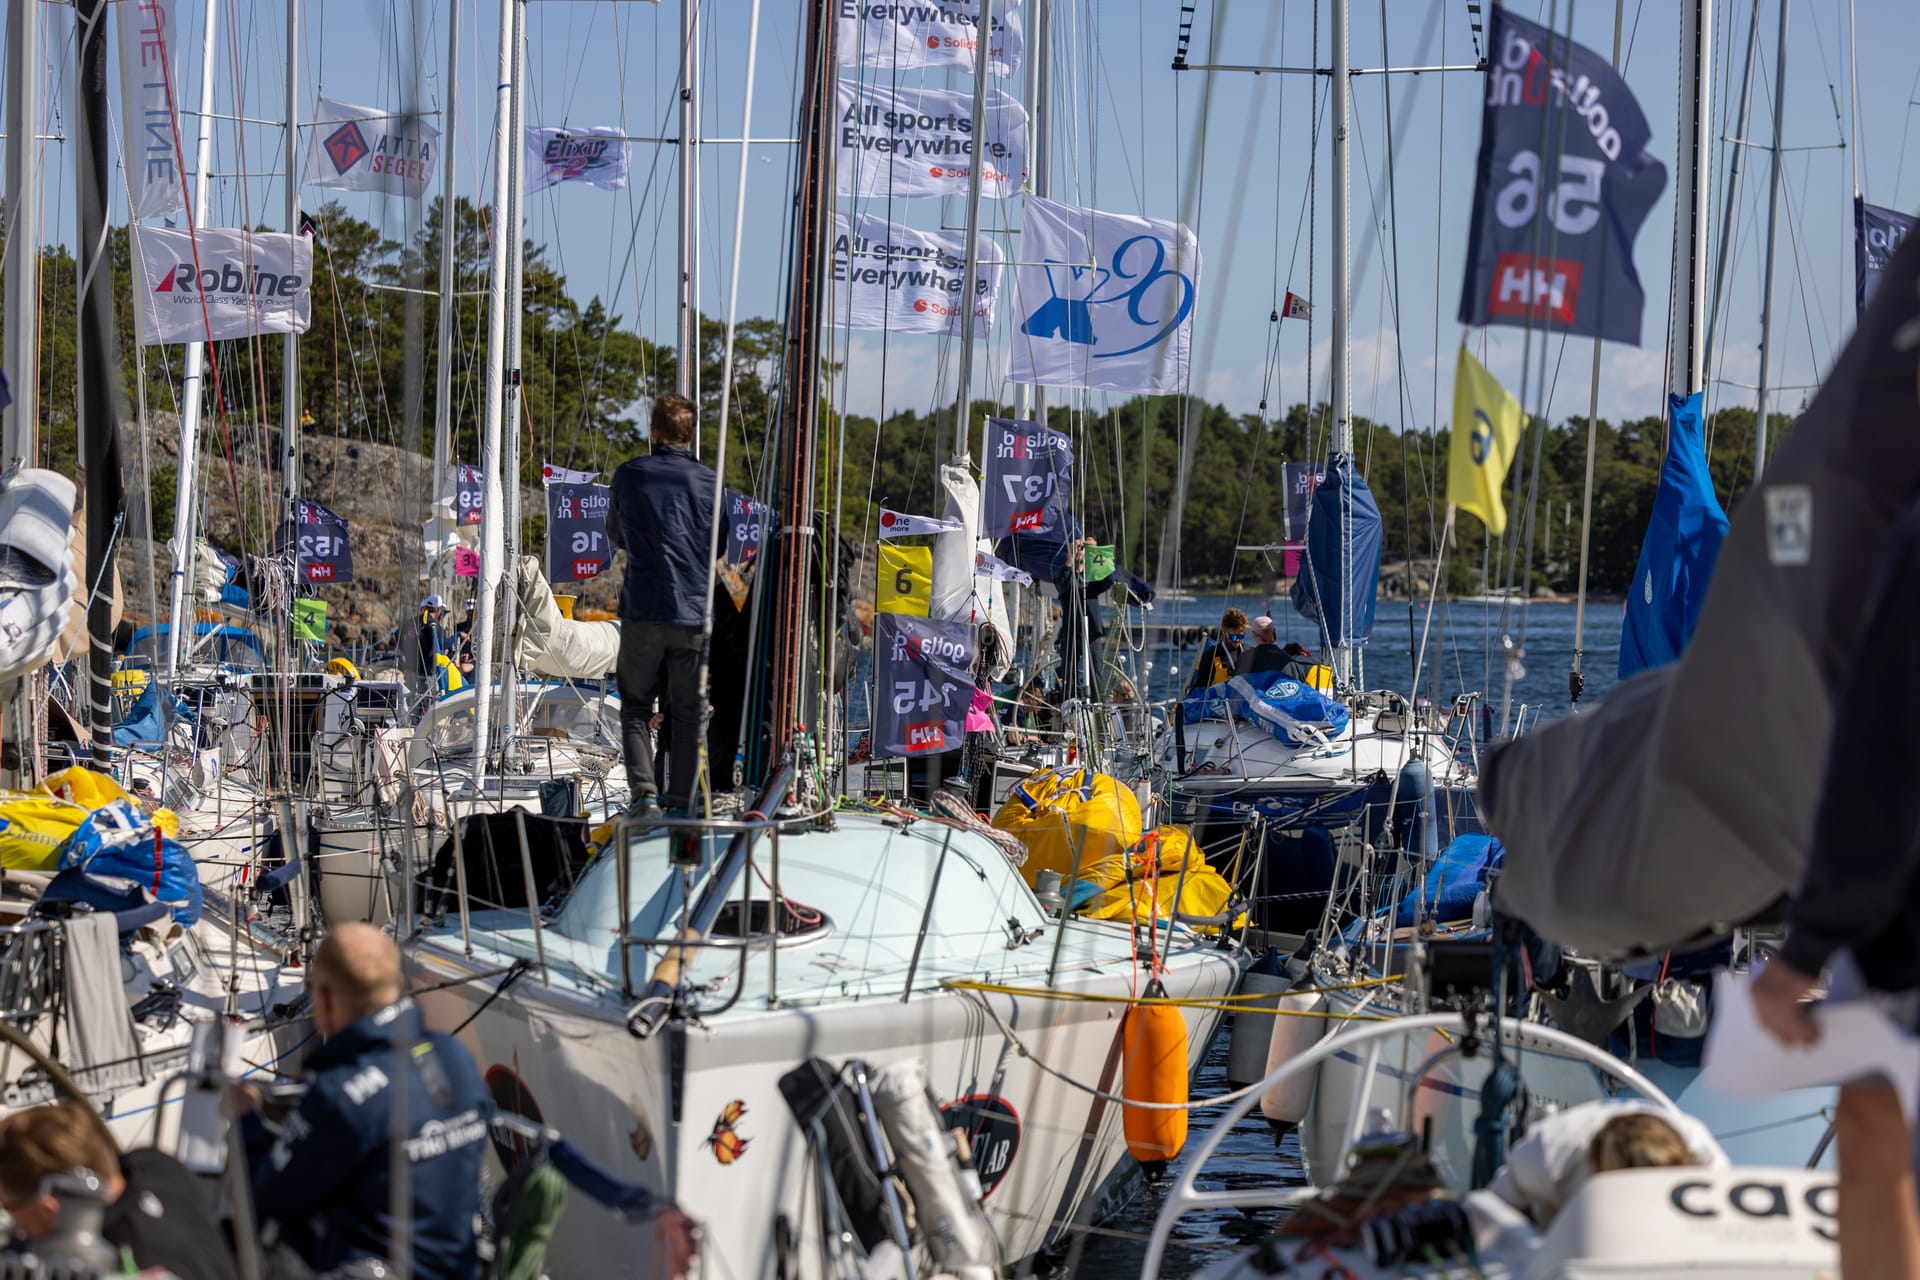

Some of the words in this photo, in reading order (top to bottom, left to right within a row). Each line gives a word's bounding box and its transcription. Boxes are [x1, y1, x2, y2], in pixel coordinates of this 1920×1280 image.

[842, 104, 878, 127] All
[377, 134, 430, 161] ATTA
[545, 139, 609, 164] Elixir
[373, 155, 426, 182] SEGEL
[562, 156, 588, 177] 2
[832, 234, 869, 258] All
[176, 264, 302, 297] Robline
[463, 553, 471, 567] 3
[1092, 553, 1105, 566] 4
[895, 568, 913, 594] 6
[302, 611, 316, 627] 4
[984, 1139, 1010, 1175] AB
